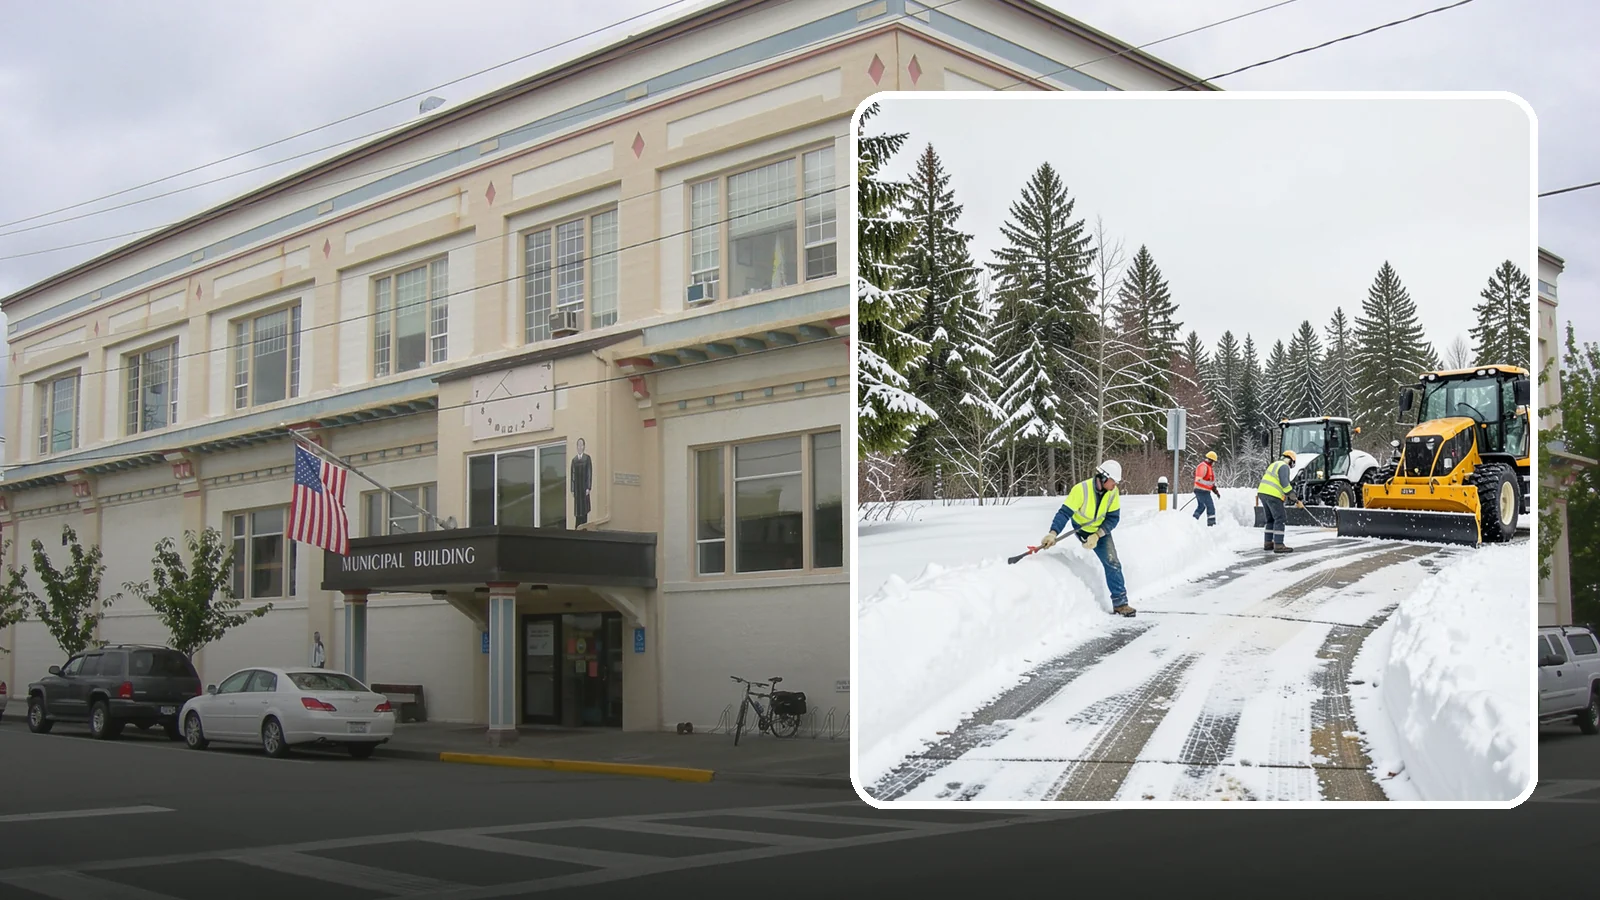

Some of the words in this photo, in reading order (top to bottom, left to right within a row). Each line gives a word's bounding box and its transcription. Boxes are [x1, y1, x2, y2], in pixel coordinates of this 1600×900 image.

[480, 407, 485, 415] 8
[528, 413, 533, 422] 3
[488, 418, 492, 426] 9
[342, 552, 405, 572] MUNICIPAL
[414, 546, 475, 567] BUILDING
